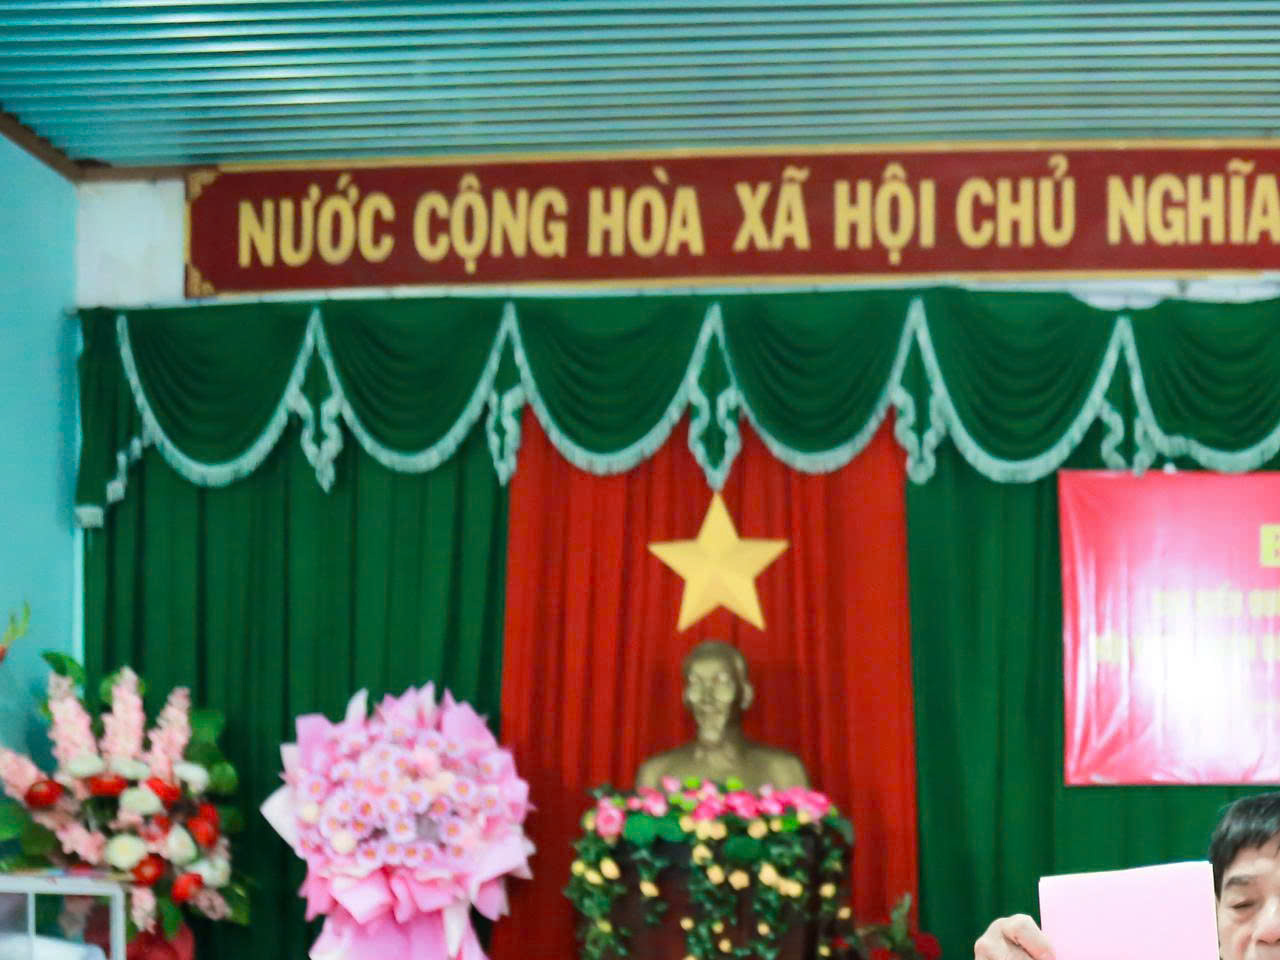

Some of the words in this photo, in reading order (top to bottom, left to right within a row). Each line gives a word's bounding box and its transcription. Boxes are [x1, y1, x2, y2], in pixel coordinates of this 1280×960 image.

[238, 174, 395, 267] NƯỚC
[413, 173, 569, 274] CỘNG
[587, 167, 705, 258] HÒA
[733, 167, 811, 252] XÃ
[833, 162, 936, 265] HỘI
[955, 155, 1077, 248] CHỦ
